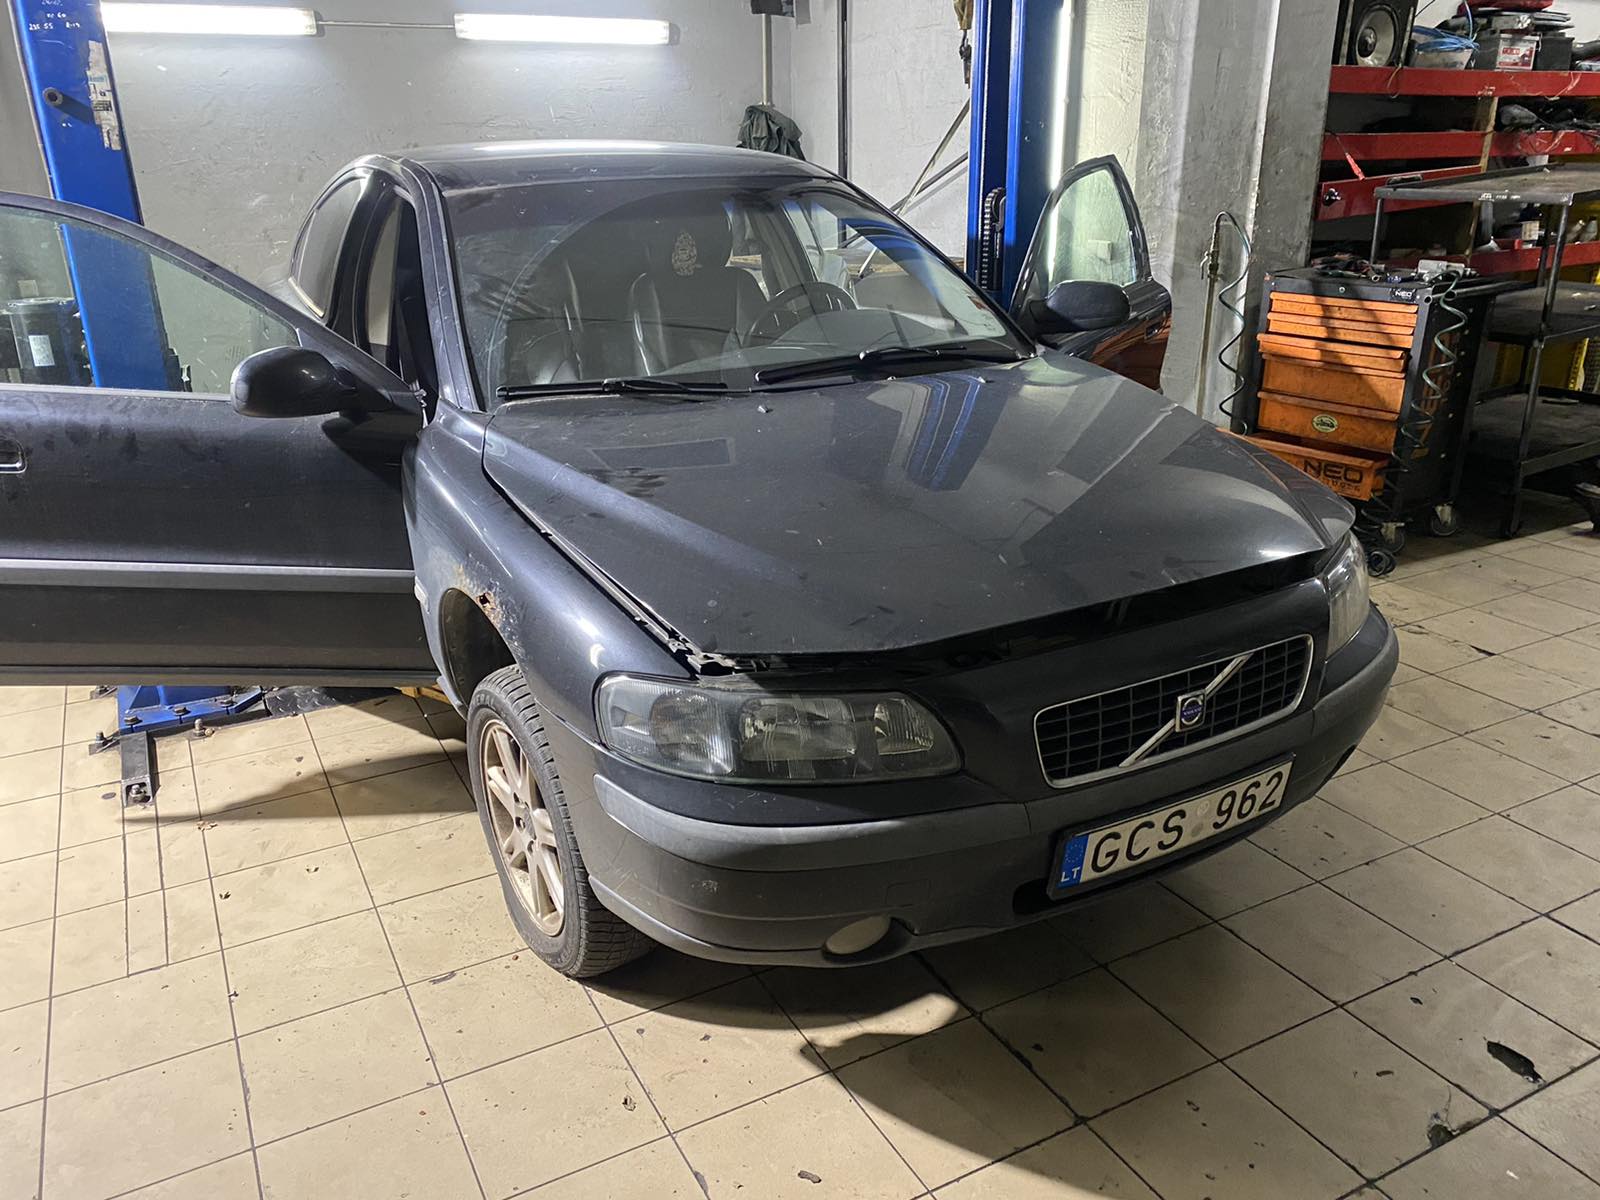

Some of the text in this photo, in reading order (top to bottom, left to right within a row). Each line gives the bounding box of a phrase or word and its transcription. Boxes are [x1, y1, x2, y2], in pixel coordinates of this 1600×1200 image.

[1303, 459, 1364, 484] NEO
[1091, 770, 1284, 873] GCS 962
[1061, 866, 1081, 882] LT
